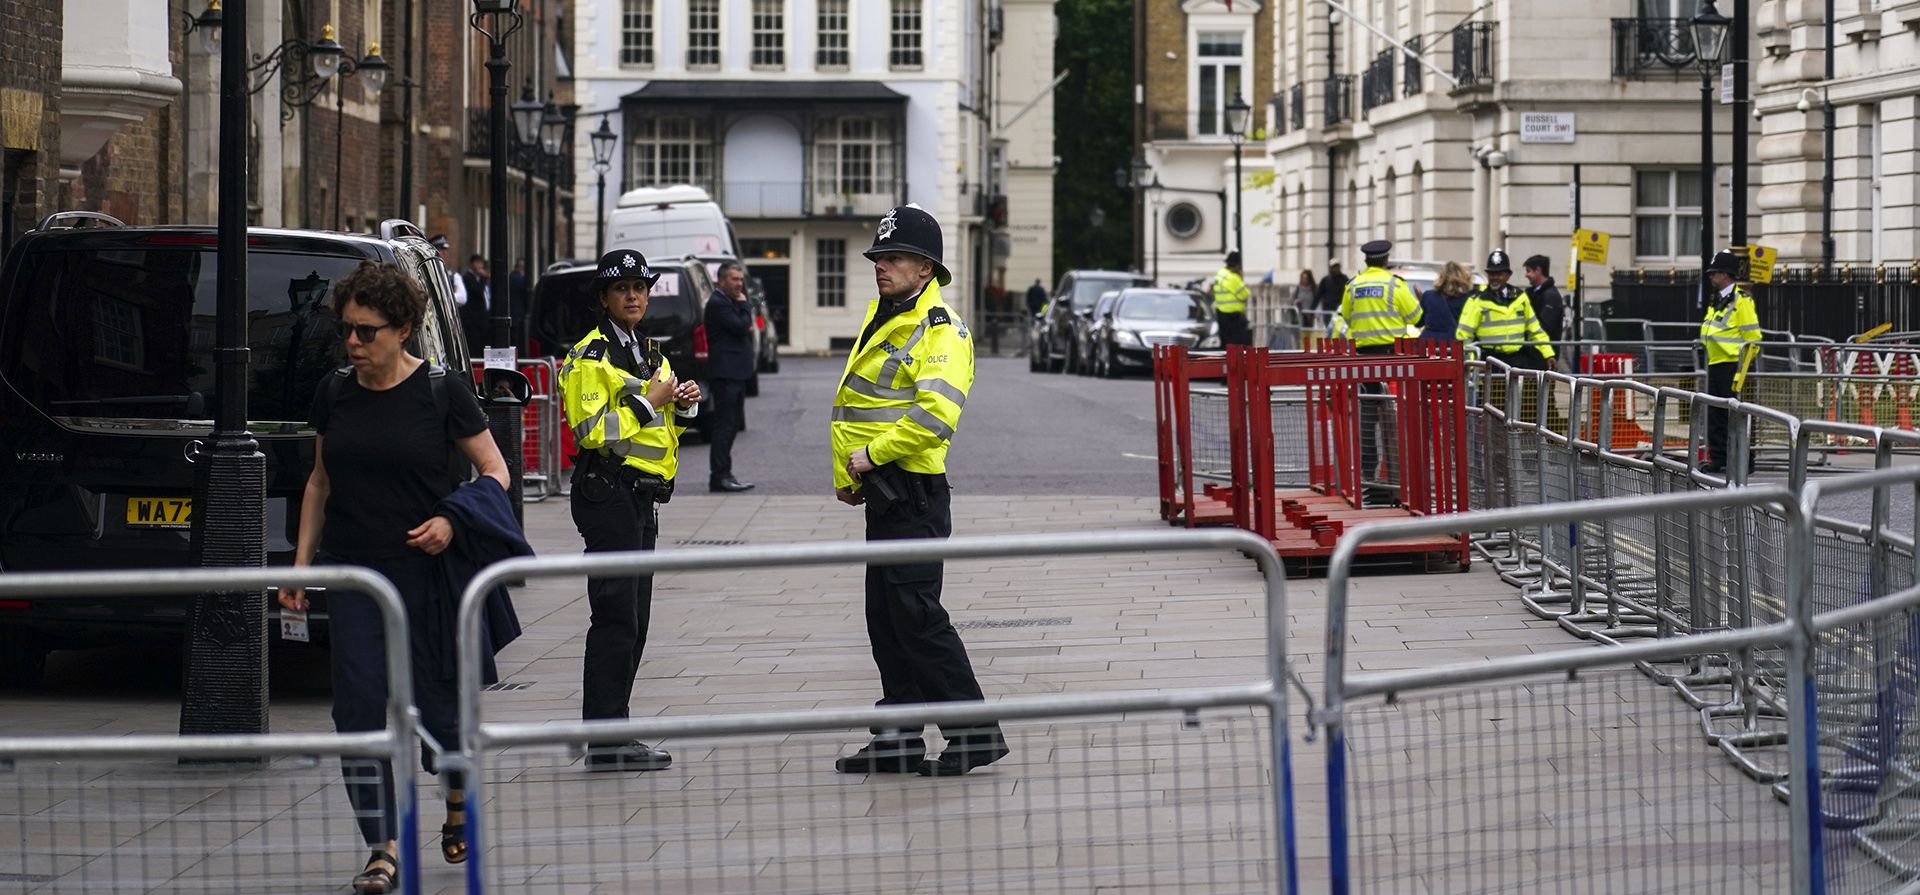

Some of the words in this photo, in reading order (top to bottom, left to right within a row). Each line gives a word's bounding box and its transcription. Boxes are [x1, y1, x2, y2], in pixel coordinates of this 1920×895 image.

[1525, 114, 1557, 123] RUSSELL
[1525, 124, 1550, 132] COURT
[1554, 124, 1570, 132] SW1
[581, 391, 599, 402] OLICE
